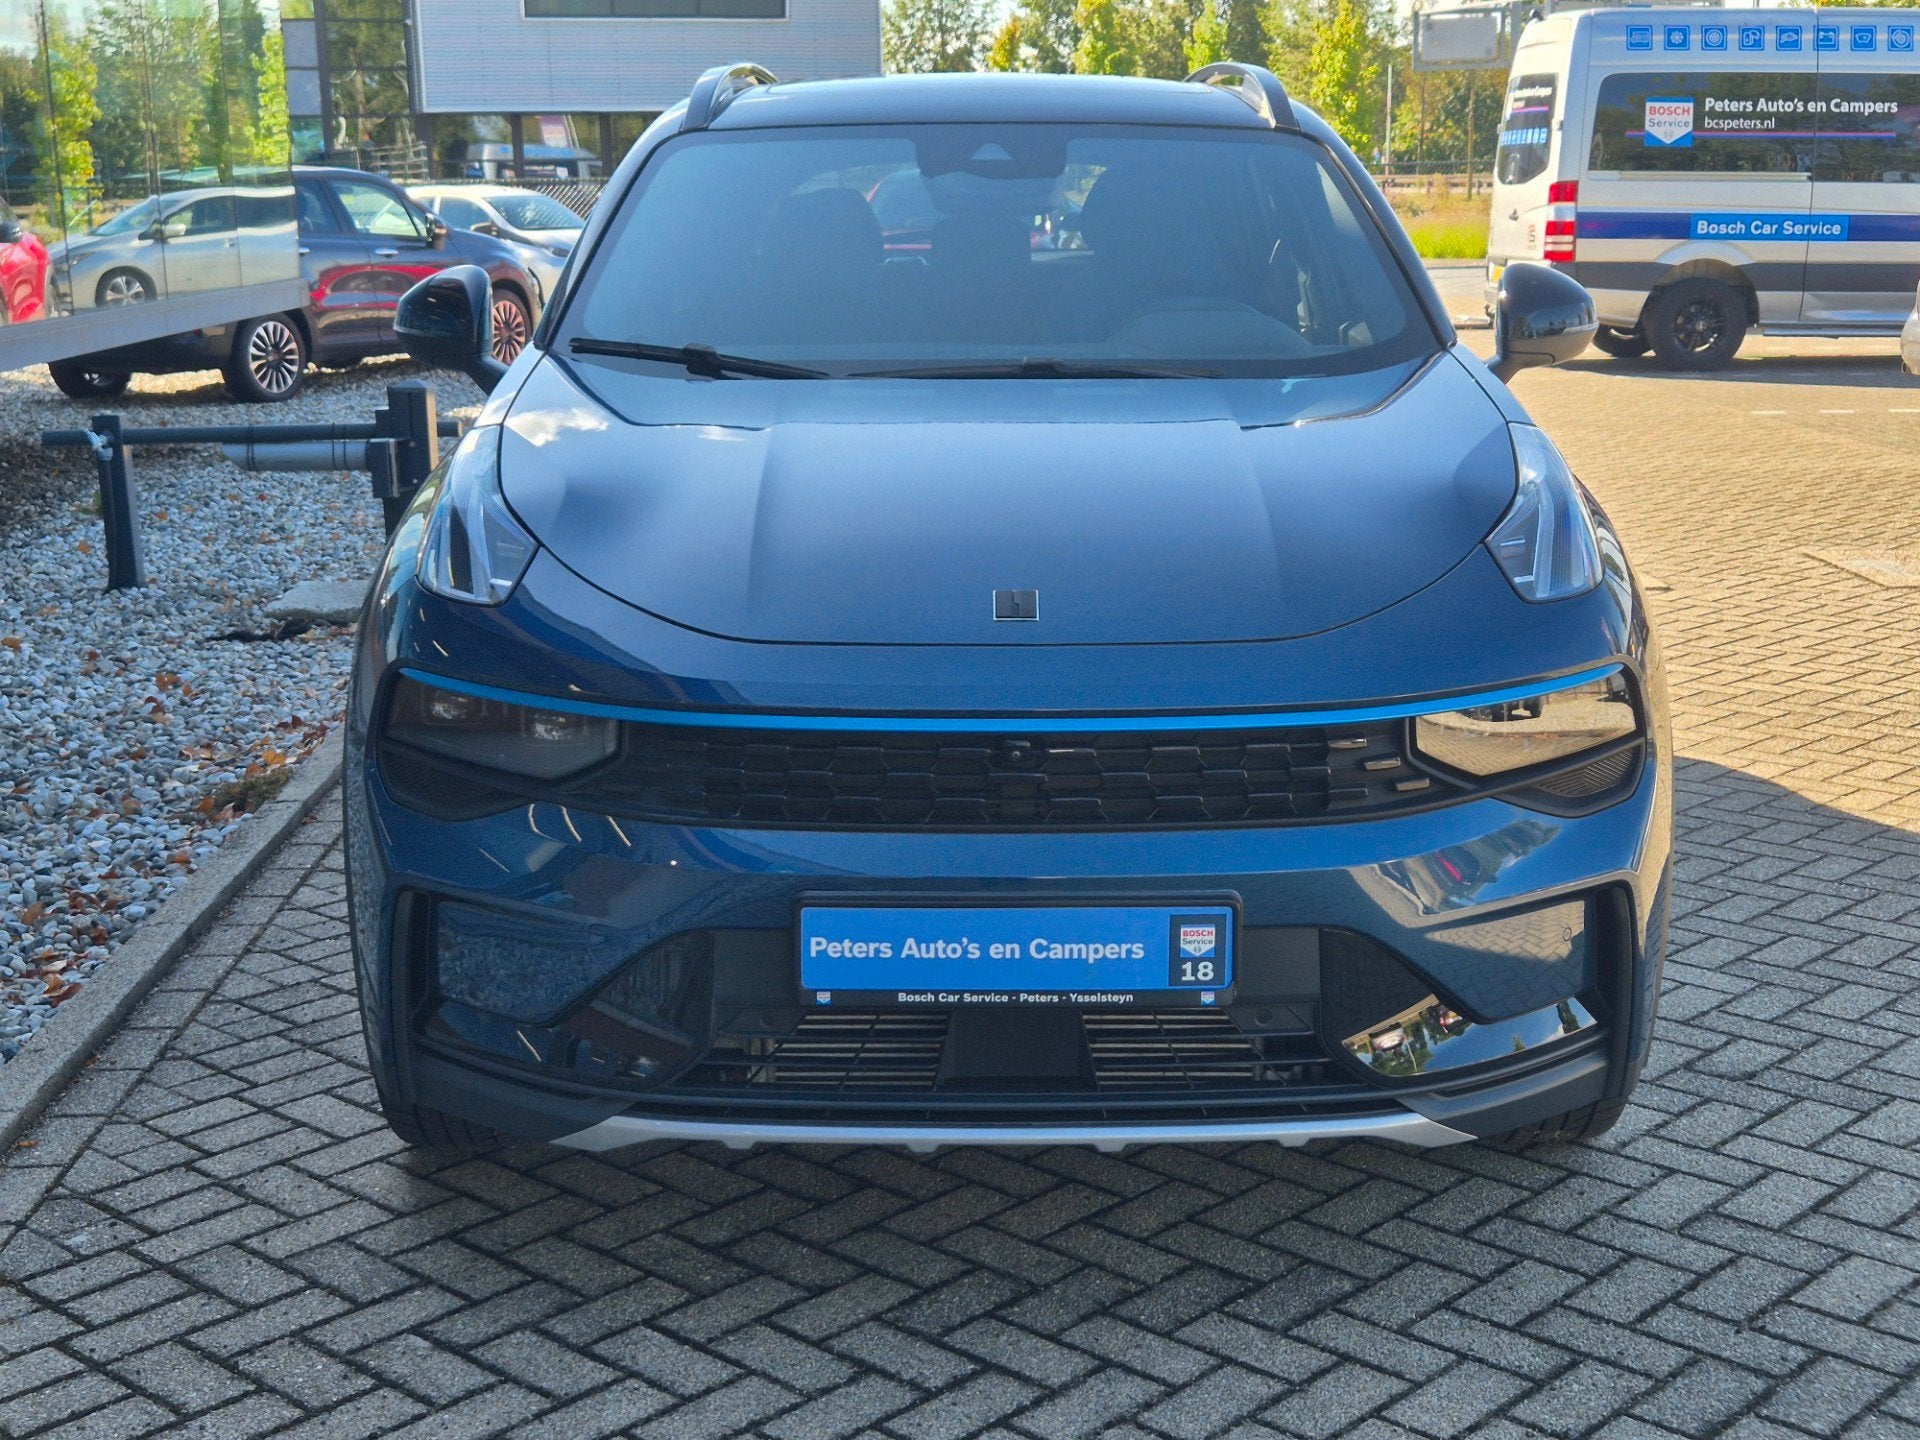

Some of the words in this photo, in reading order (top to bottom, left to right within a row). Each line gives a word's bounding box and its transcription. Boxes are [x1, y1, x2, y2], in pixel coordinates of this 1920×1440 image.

[1648, 106, 1690, 116] BOSCH
[1704, 97, 1753, 112] Peters
[1756, 98, 1804, 112] Auto's
[1807, 101, 1826, 112] en
[1830, 98, 1898, 116] Campers
[1648, 118, 1690, 127] Service
[1704, 115, 1775, 131] bcspeters.nl
[1697, 220, 1745, 234] Bosch
[1750, 220, 1778, 235] Car
[1782, 220, 1841, 235] Service
[1182, 929, 1213, 937] BOSCH
[810, 937, 893, 958] Peters
[901, 937, 980, 959] Auto's
[989, 942, 1020, 959] en
[1029, 938, 1144, 964] Campers
[1181, 961, 1214, 981] 18
[898, 992, 934, 1002] Bosch
[939, 993, 960, 1002] Car
[963, 992, 1008, 1002] Service
[1020, 993, 1059, 1002] Peters
[1069, 993, 1133, 1004] Ysselsteyn
